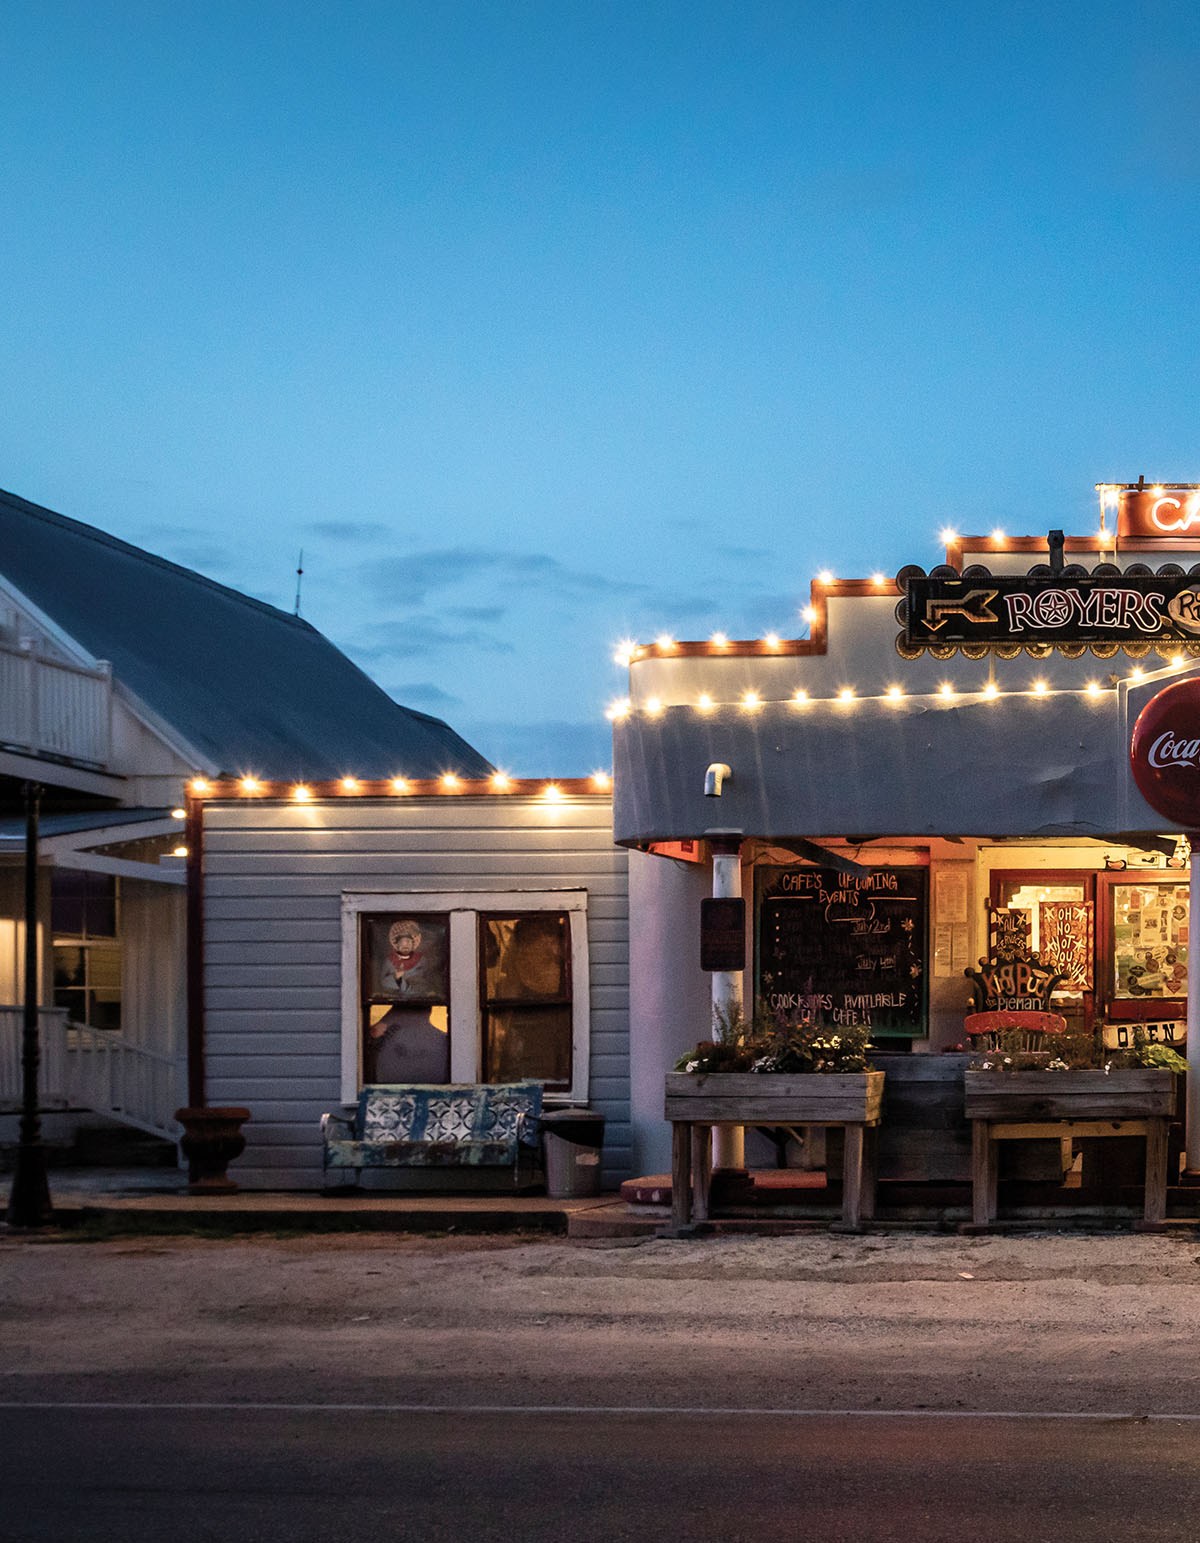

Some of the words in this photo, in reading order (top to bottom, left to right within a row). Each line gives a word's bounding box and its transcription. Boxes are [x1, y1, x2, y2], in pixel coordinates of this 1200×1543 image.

[1003, 588, 1165, 632] ROYERS
[782, 872, 823, 891] CAFE'S
[819, 890, 860, 906] EVENTS
[1058, 907, 1072, 921] OH
[1003, 917, 1019, 932] ALL
[1056, 921, 1071, 935] NO
[1051, 934, 1076, 951] NOT
[1052, 949, 1073, 961] YOU
[844, 992, 907, 1009] AVAILABLE
[1117, 1023, 1176, 1048] OEN
